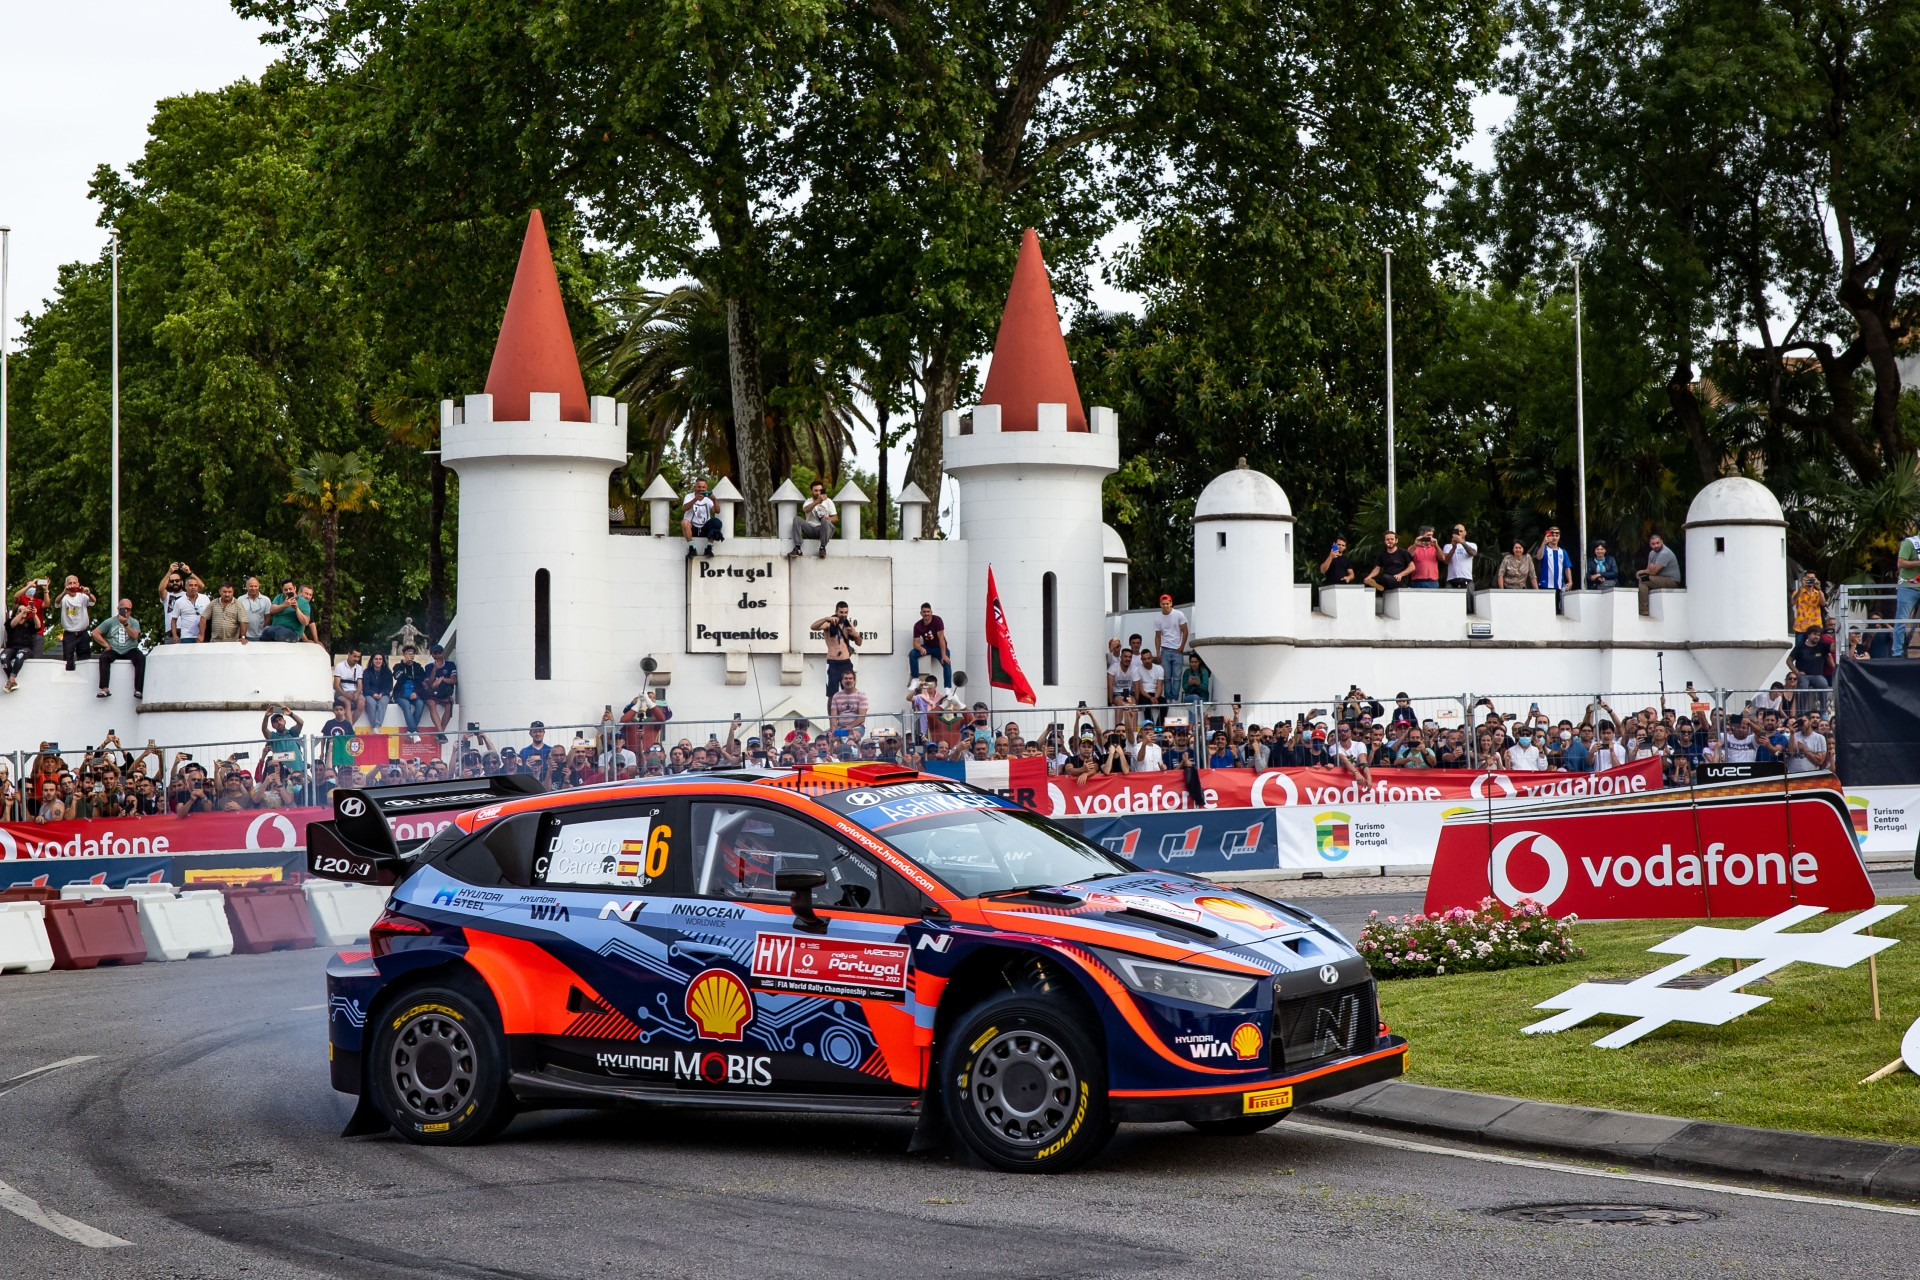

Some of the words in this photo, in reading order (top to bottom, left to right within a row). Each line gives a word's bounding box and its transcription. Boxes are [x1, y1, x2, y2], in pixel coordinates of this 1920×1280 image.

[700, 561, 773, 582] Portugal
[738, 592, 767, 609] dos
[696, 624, 779, 646] Pequenitos
[1707, 766, 1751, 777] WRC
[876, 782, 945, 798] HYUNDAI
[1305, 779, 1442, 804] vodafone
[478, 806, 504, 819] OMP
[1355, 823, 1385, 831] Turismo
[1355, 831, 1380, 839] Centro
[1874, 824, 1907, 832] Portugal
[25, 831, 169, 858] vodafone
[549, 837, 565, 852] D.
[572, 837, 621, 854] Sordo
[645, 824, 672, 878] 6
[1355, 838, 1388, 847] Portugal
[535, 857, 551, 874] C.
[558, 856, 616, 874] Carrera
[836, 821, 935, 892] motorsport.hyundai.com
[1581, 842, 1818, 887] vodafone
[849, 854, 878, 880] HYUNDAI
[457, 888, 503, 902] HYUNDAI
[519, 895, 557, 904] HYUNDAI
[452, 897, 485, 911] STEEL
[530, 903, 570, 922] WIA
[671, 903, 745, 920] INNOCEAN
[685, 917, 726, 928] WORLDWIDE
[757, 937, 790, 972] HY
[829, 958, 901, 977] Portugal
[885, 975, 901, 983] 2022
[789, 982, 807, 990] World
[808, 983, 824, 993] Rally
[825, 985, 867, 997] Championship
[1175, 1034, 1214, 1044] HYUNDAI
[1190, 1039, 1233, 1058] WIA
[597, 1053, 669, 1072] HYUNDAI
[674, 1051, 773, 1087] MOBIS
[1248, 1091, 1289, 1109] PIRELLI
[1037, 1080, 1090, 1160] SCORPION
